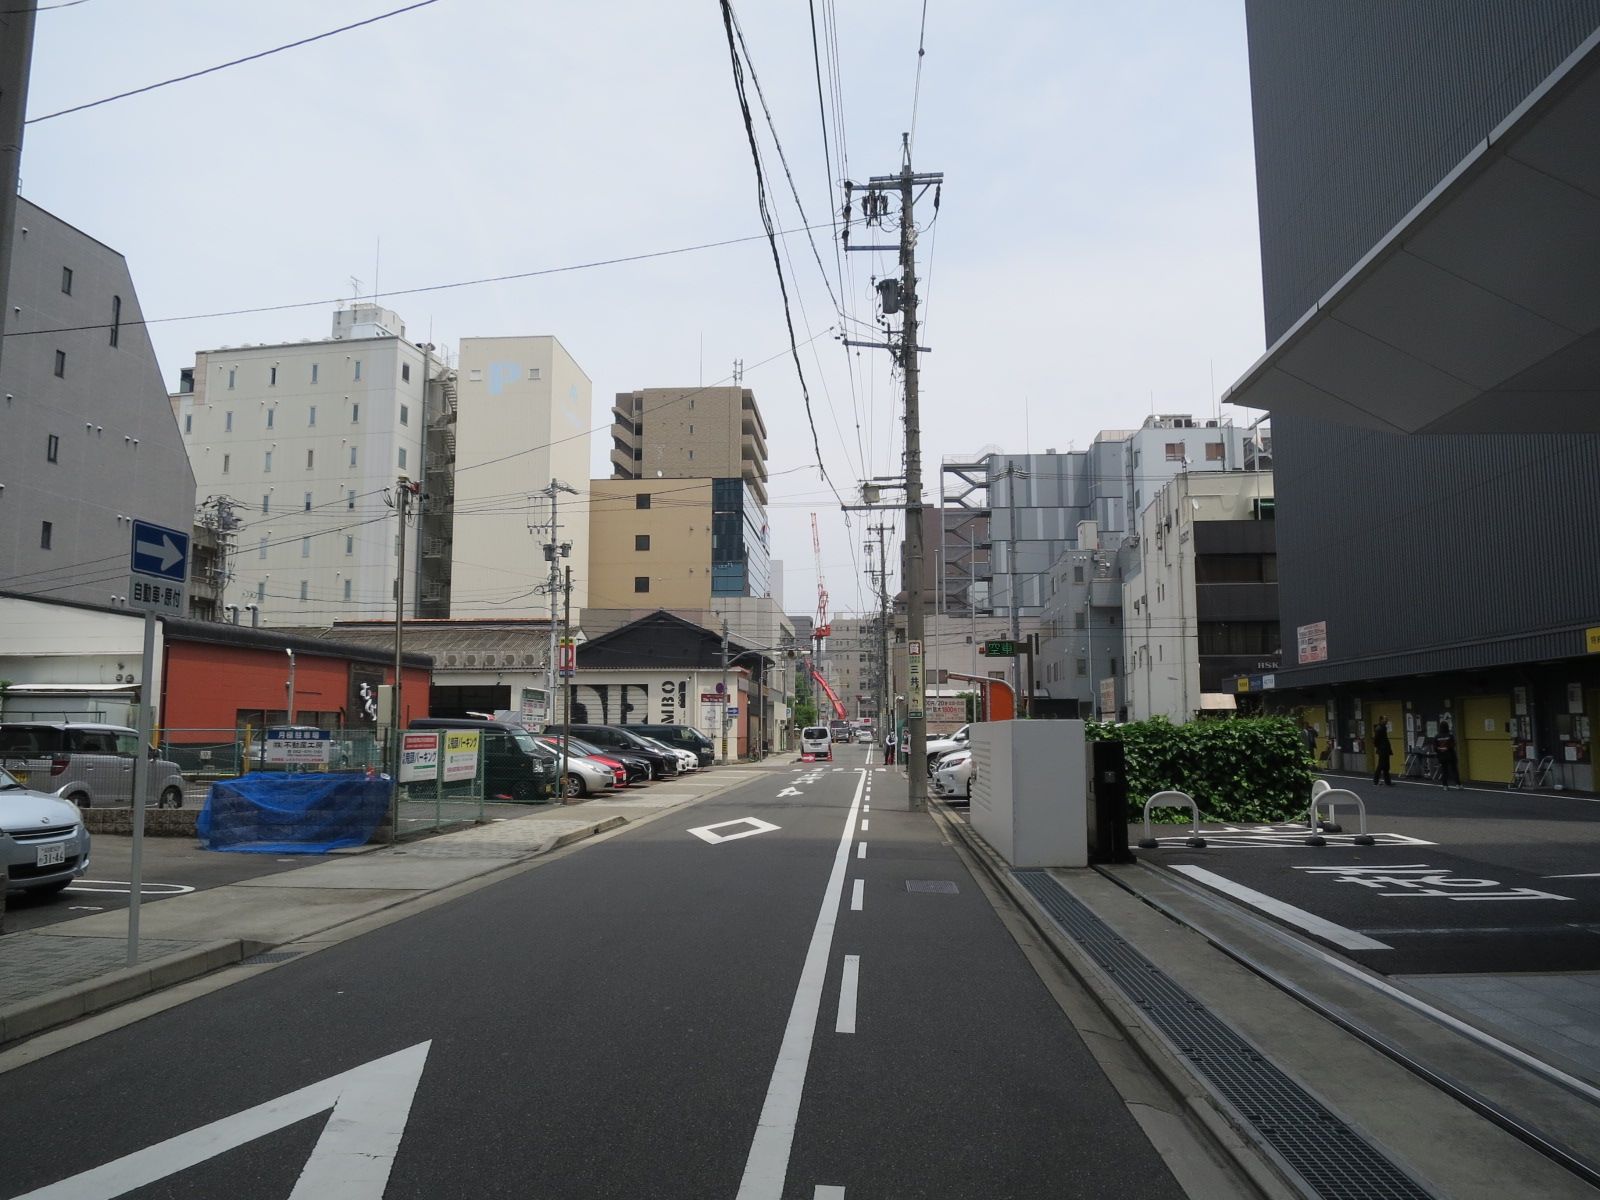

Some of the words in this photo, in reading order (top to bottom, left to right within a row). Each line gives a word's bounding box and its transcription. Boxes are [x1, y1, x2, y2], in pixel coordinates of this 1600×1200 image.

[134, 583, 181, 607] 自動車・原付
[989, 642, 1012, 654] 空車
